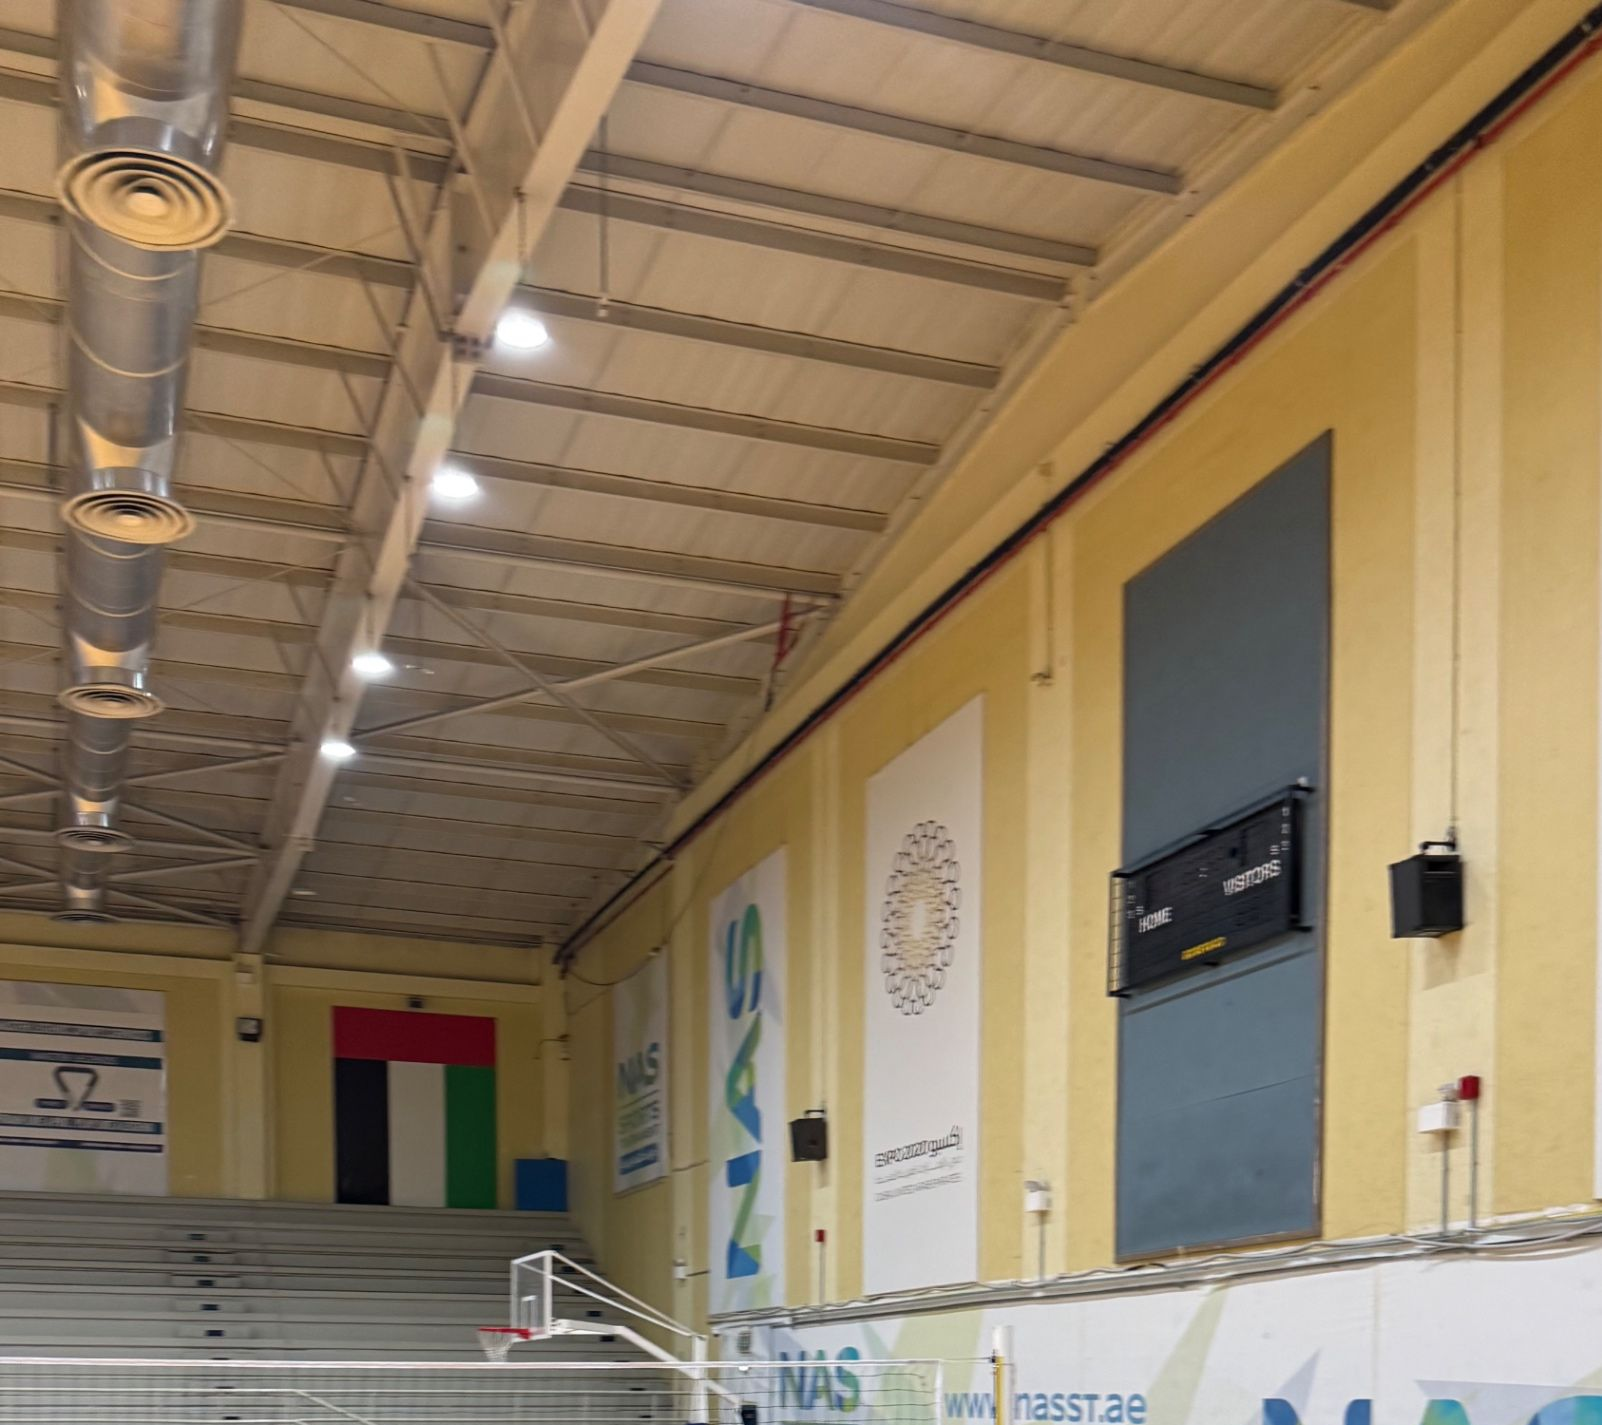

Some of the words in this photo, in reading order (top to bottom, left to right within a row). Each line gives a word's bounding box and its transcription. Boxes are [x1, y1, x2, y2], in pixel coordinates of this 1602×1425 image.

[1223, 859, 1281, 896] VISITORS
[1138, 906, 1174, 934] HOME
[617, 1041, 660, 1101] NAS
[725, 903, 763, 1280] NAS
[778, 1346, 860, 1413] NAS
